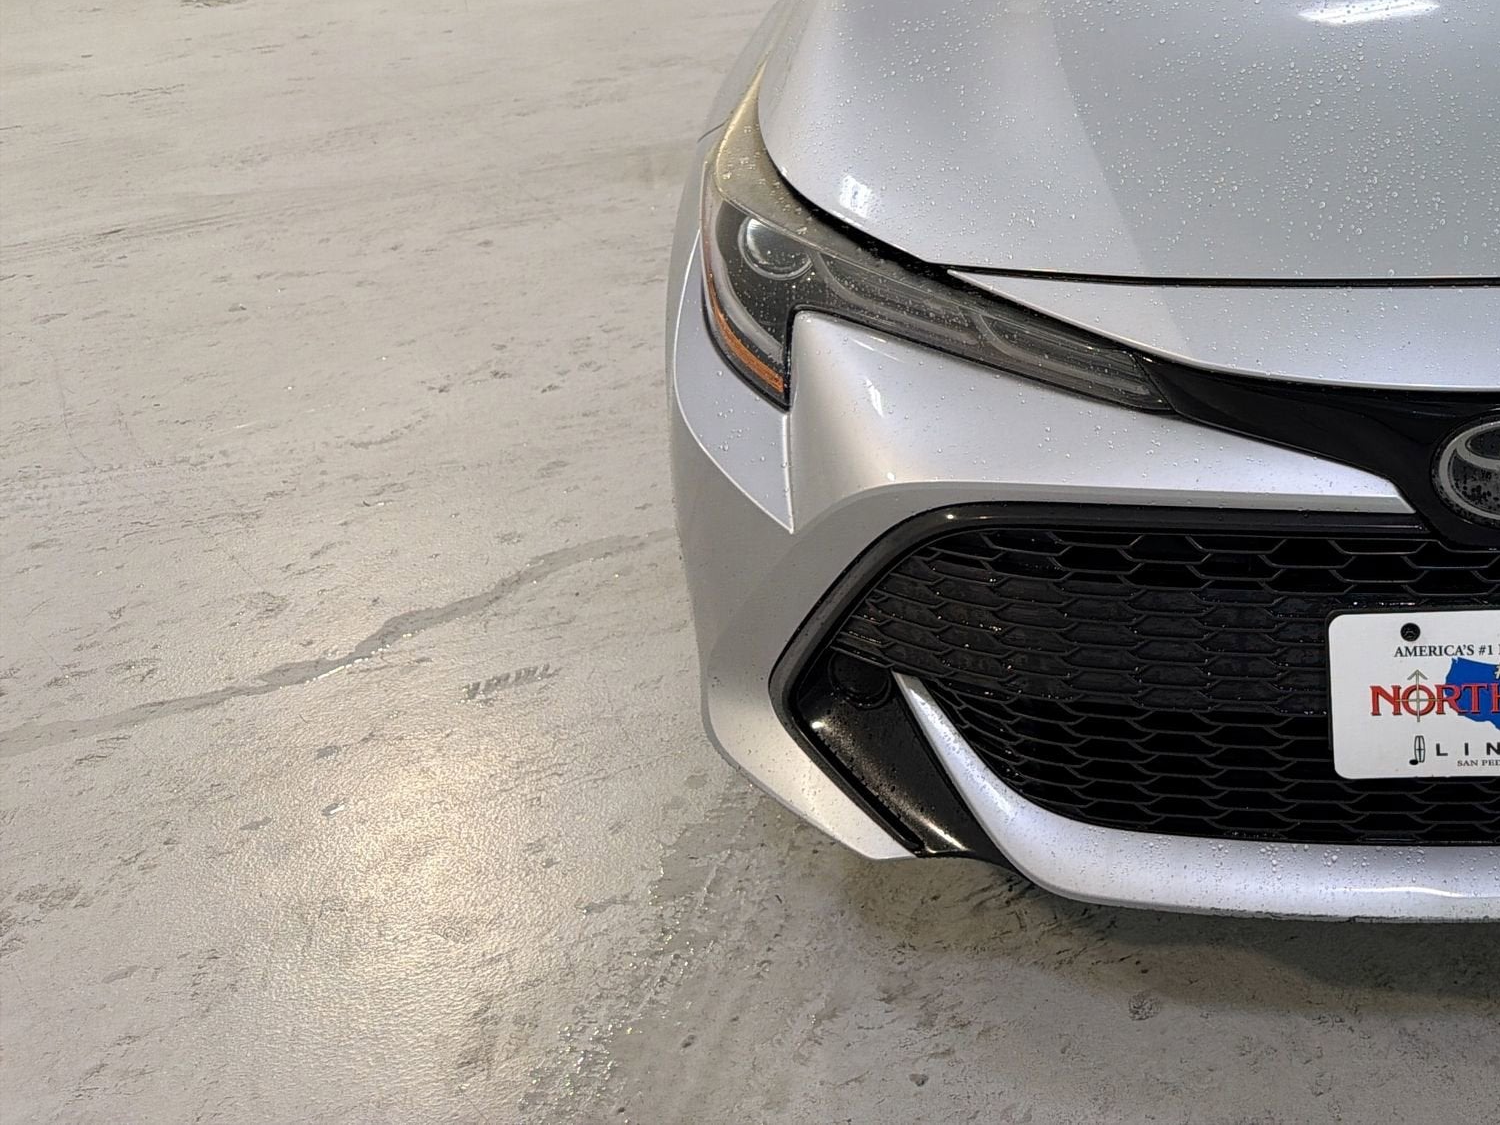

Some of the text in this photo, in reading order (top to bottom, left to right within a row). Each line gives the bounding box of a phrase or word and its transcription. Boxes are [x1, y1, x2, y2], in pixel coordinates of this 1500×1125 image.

[1394, 644, 1474, 657] AMERICA'S
[1479, 644, 1493, 655] #1
[1457, 759, 1478, 767] SAN
